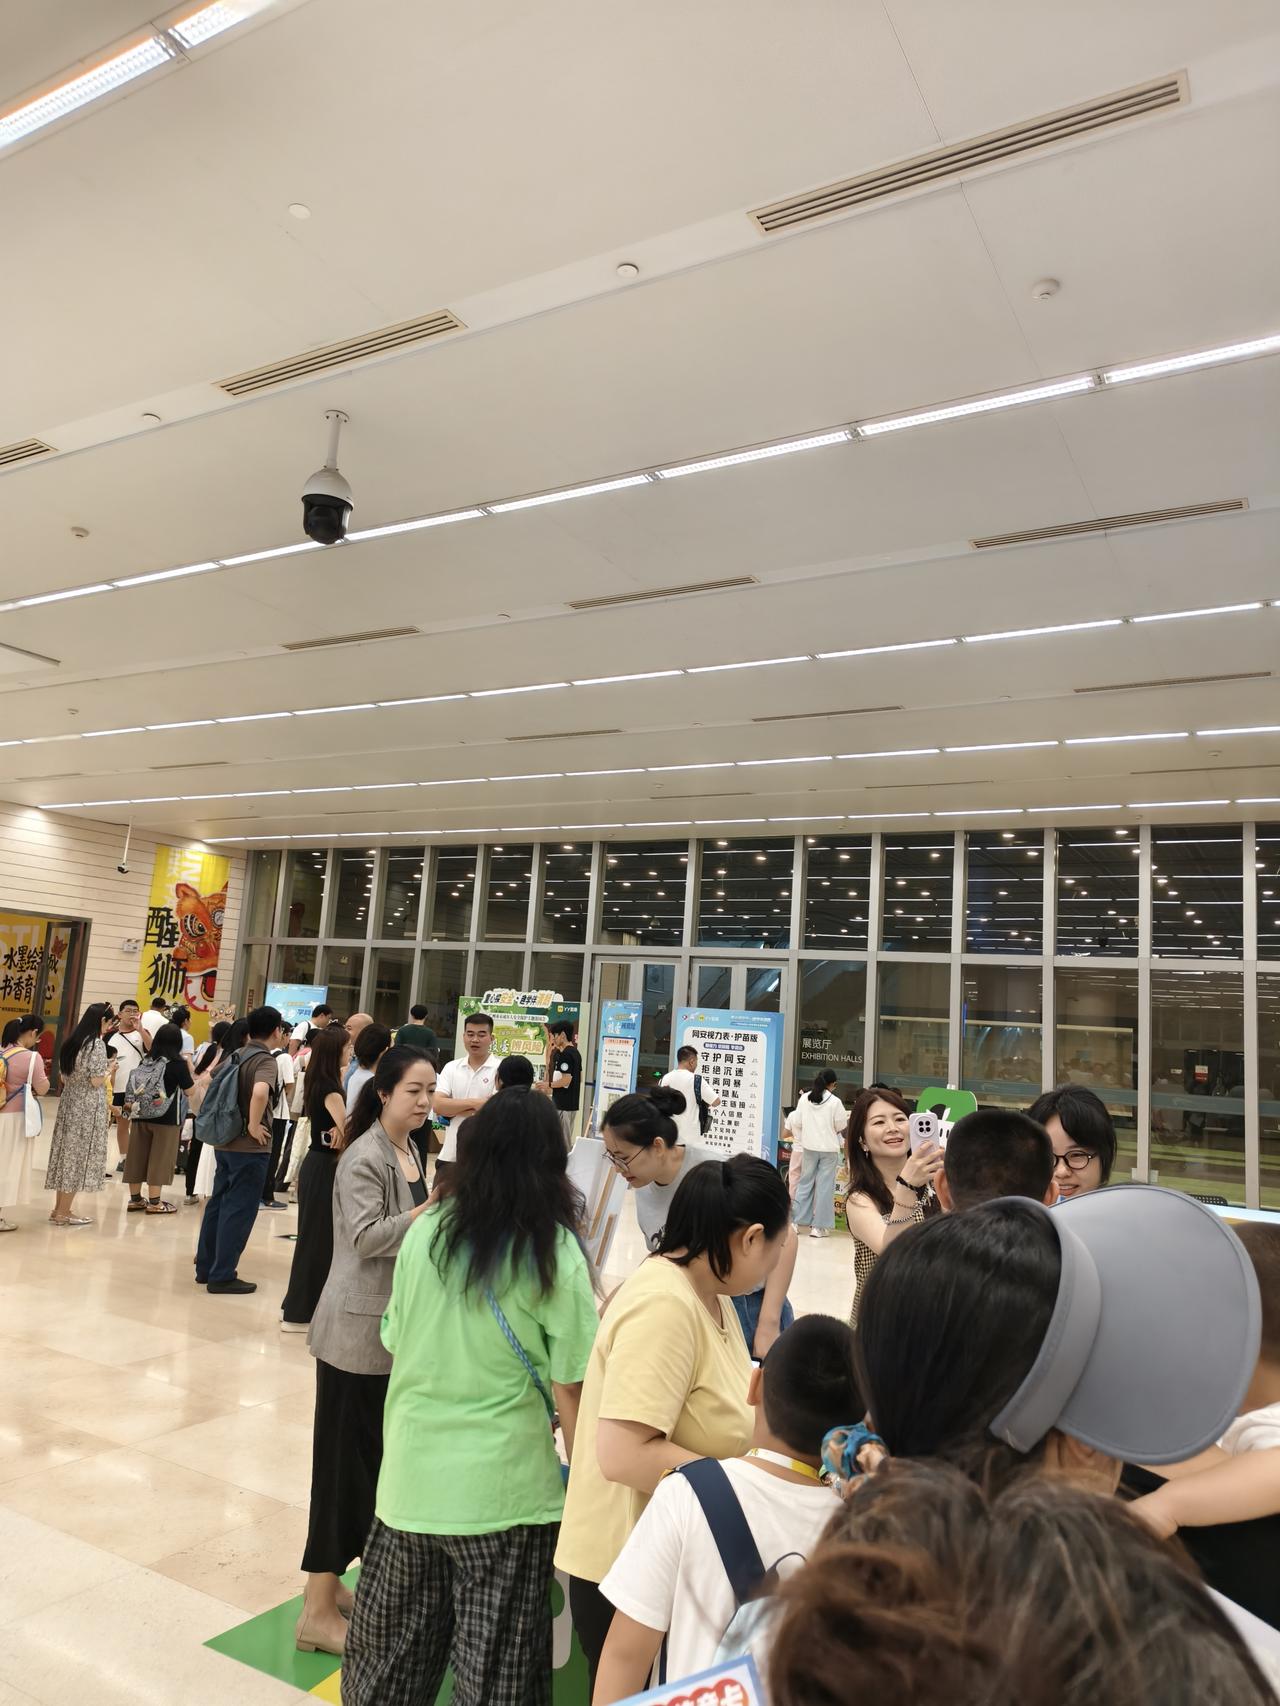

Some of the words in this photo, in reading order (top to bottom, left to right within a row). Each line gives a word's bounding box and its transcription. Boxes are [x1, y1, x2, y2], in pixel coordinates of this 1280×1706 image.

[145, 906, 188, 999] 醒狮
[0, 974, 55, 1004] 书香育心
[802, 1038, 832, 1050] 展览厅
[801, 1052, 839, 1062] EXHIBITION
[841, 1055, 863, 1064] HALLS
[701, 1064, 744, 1077] 拒绝沉迷
